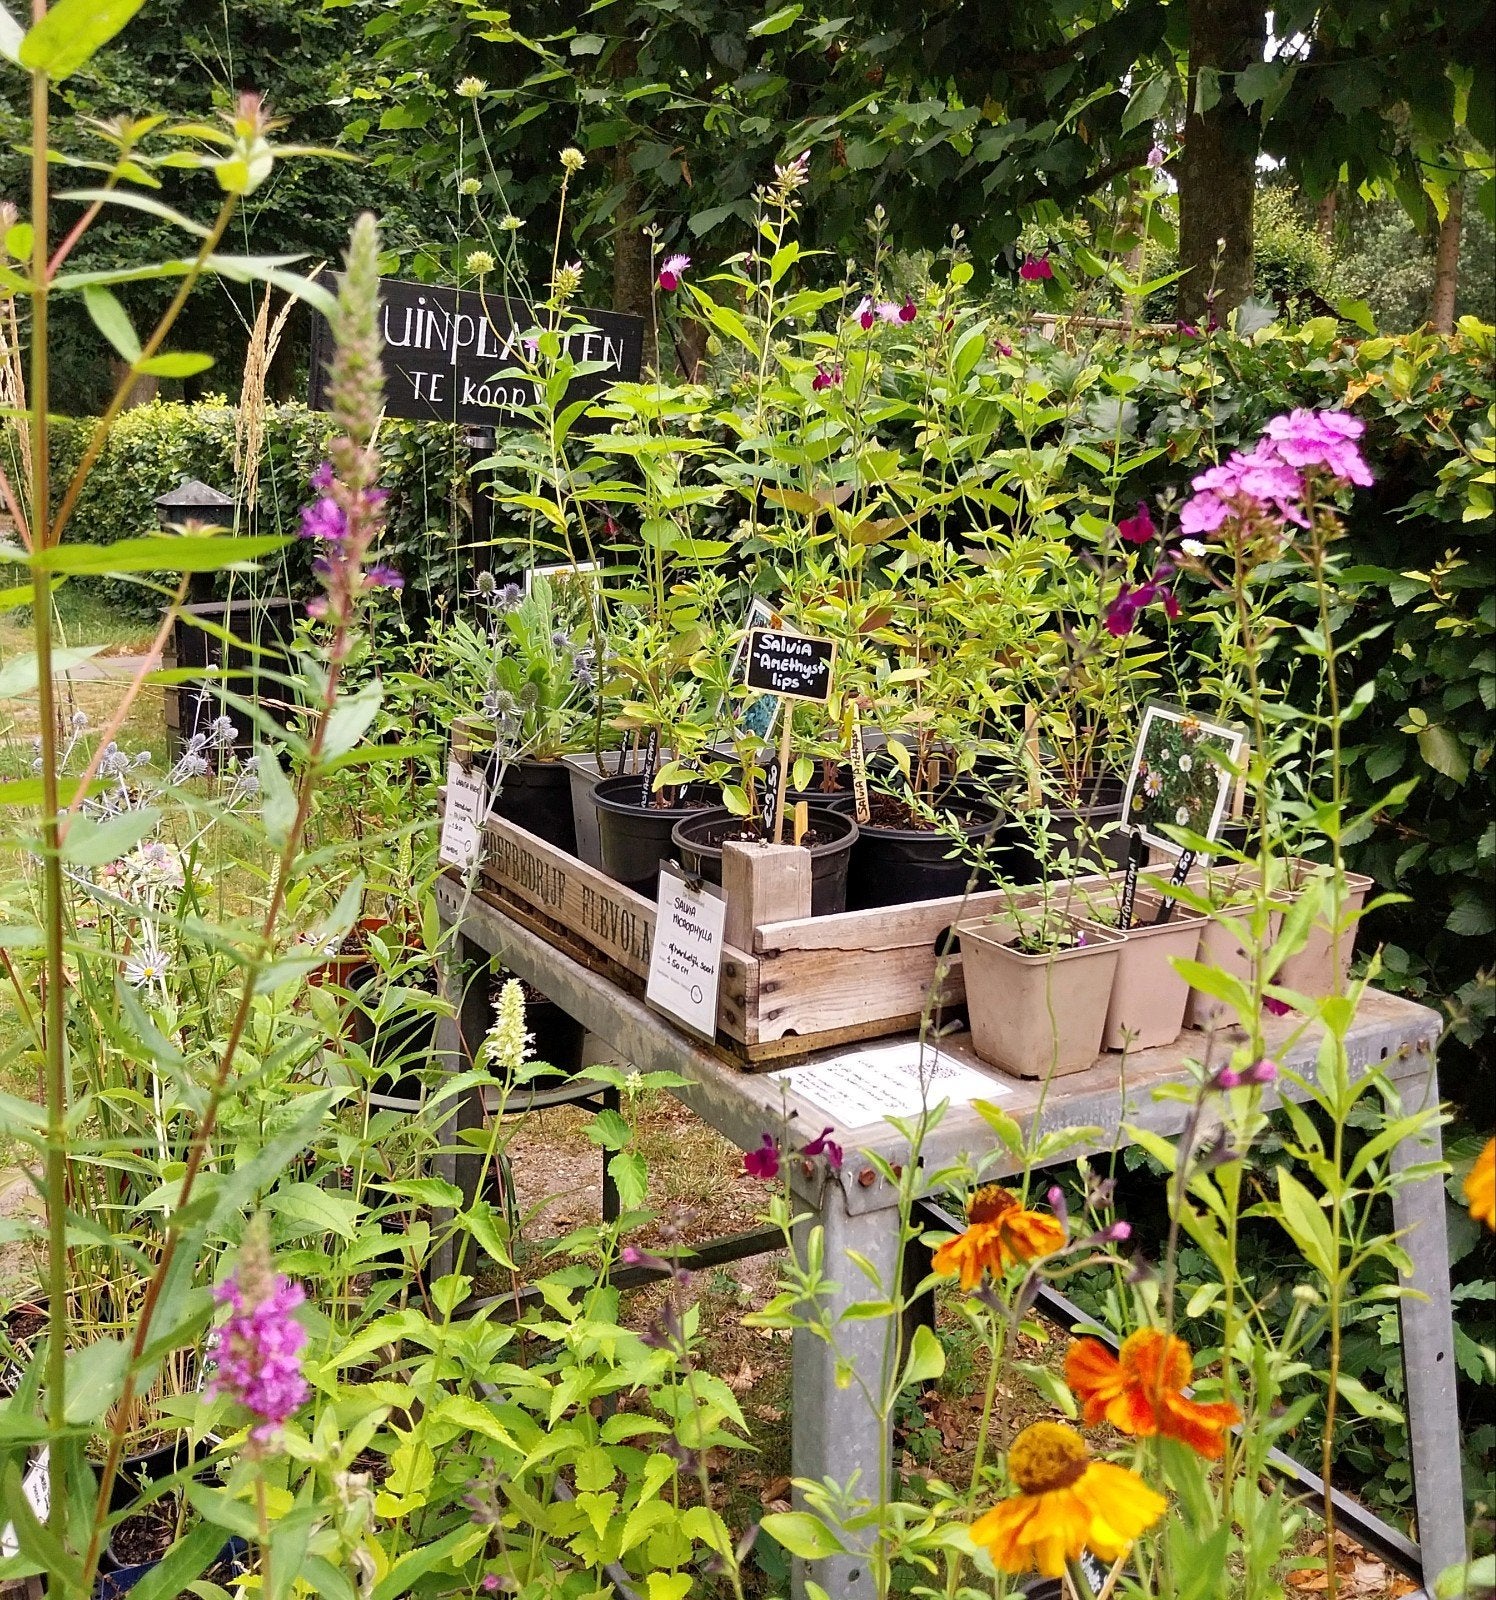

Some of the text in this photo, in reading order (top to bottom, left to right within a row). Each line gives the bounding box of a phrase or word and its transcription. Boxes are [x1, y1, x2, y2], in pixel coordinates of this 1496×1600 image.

[377, 296, 624, 372] UINPLATEN
[409, 371, 445, 402] TE
[581, 883, 656, 966] FLEVOLA
[674, 896, 697, 918] SALVIA
